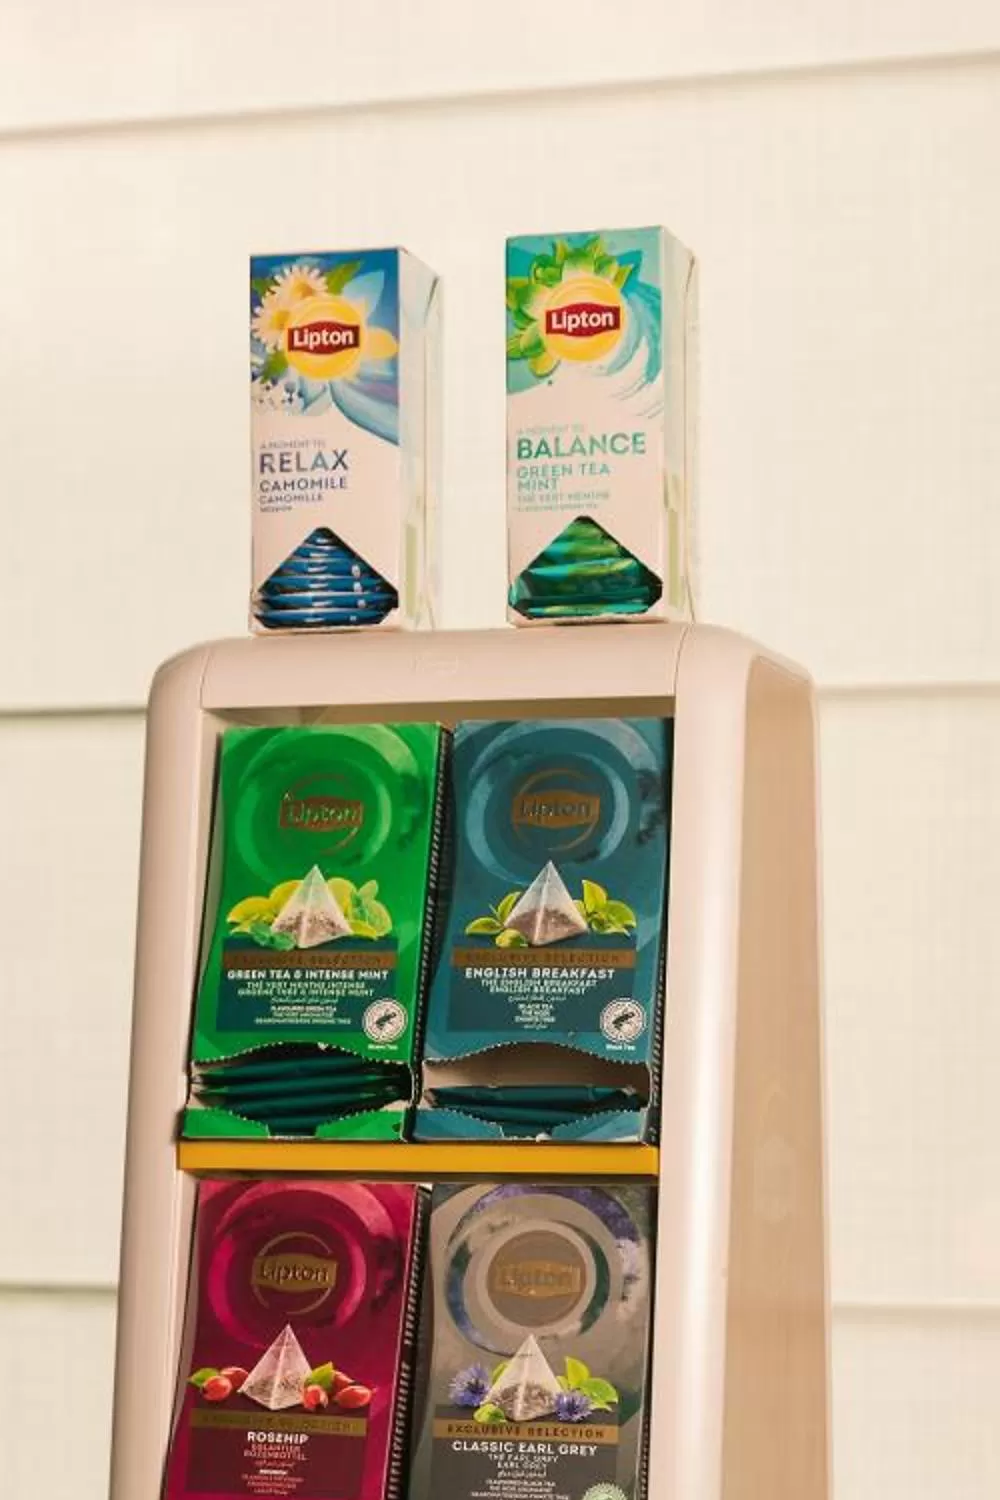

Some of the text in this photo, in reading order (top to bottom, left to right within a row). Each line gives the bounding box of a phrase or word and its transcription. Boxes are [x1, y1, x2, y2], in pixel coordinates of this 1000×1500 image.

[551, 309, 614, 338] Lipton
[293, 327, 354, 356] Lipton
[517, 432, 646, 460] BALANCE
[259, 449, 348, 474] RELAX
[517, 462, 611, 478] GREEN TEA
[259, 477, 348, 493] CAMOMILE
[517, 478, 557, 492] MINT
[227, 969, 268, 980] GREEN
[270, 969, 291, 980] TEA
[305, 969, 355, 981] INTENSE
[358, 970, 389, 981] MINT
[465, 967, 616, 980] ENGLISH BREAKFAST
[261, 1260, 329, 1285] Lipton
[247, 1431, 309, 1444] ROSEHIP
[447, 1424, 604, 1438] EXCLUSIVE SELECTION
[452, 1440, 598, 1456] CLASSIC EARL GREY
